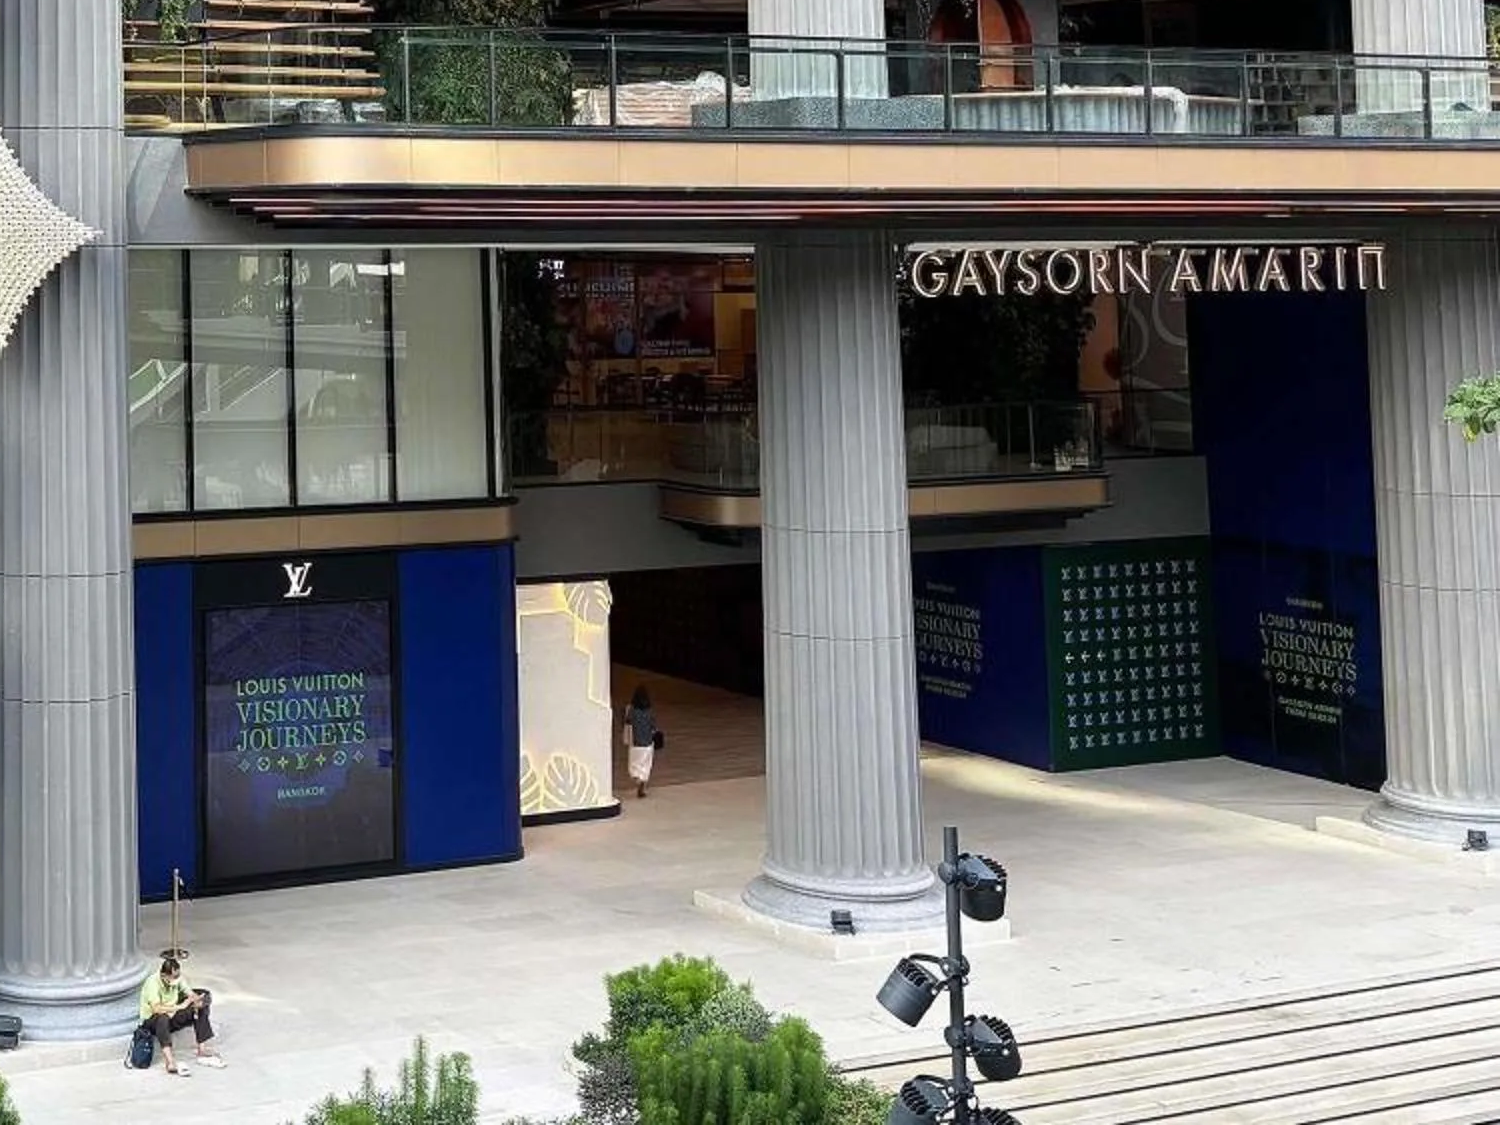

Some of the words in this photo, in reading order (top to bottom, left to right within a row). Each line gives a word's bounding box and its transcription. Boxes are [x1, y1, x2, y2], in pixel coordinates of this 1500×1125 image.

[911, 248, 1152, 297] GAYSORN
[1259, 610, 1295, 630] LOUIS
[1299, 618, 1354, 639] VUITTON
[1260, 628, 1355, 660] VISIONARY
[1261, 648, 1357, 682] JOURNEYS
[237, 677, 287, 696] LOUIS
[292, 672, 364, 692] VUITTON
[236, 694, 365, 724] VISIONARY
[237, 720, 365, 751] JOURNEYS
